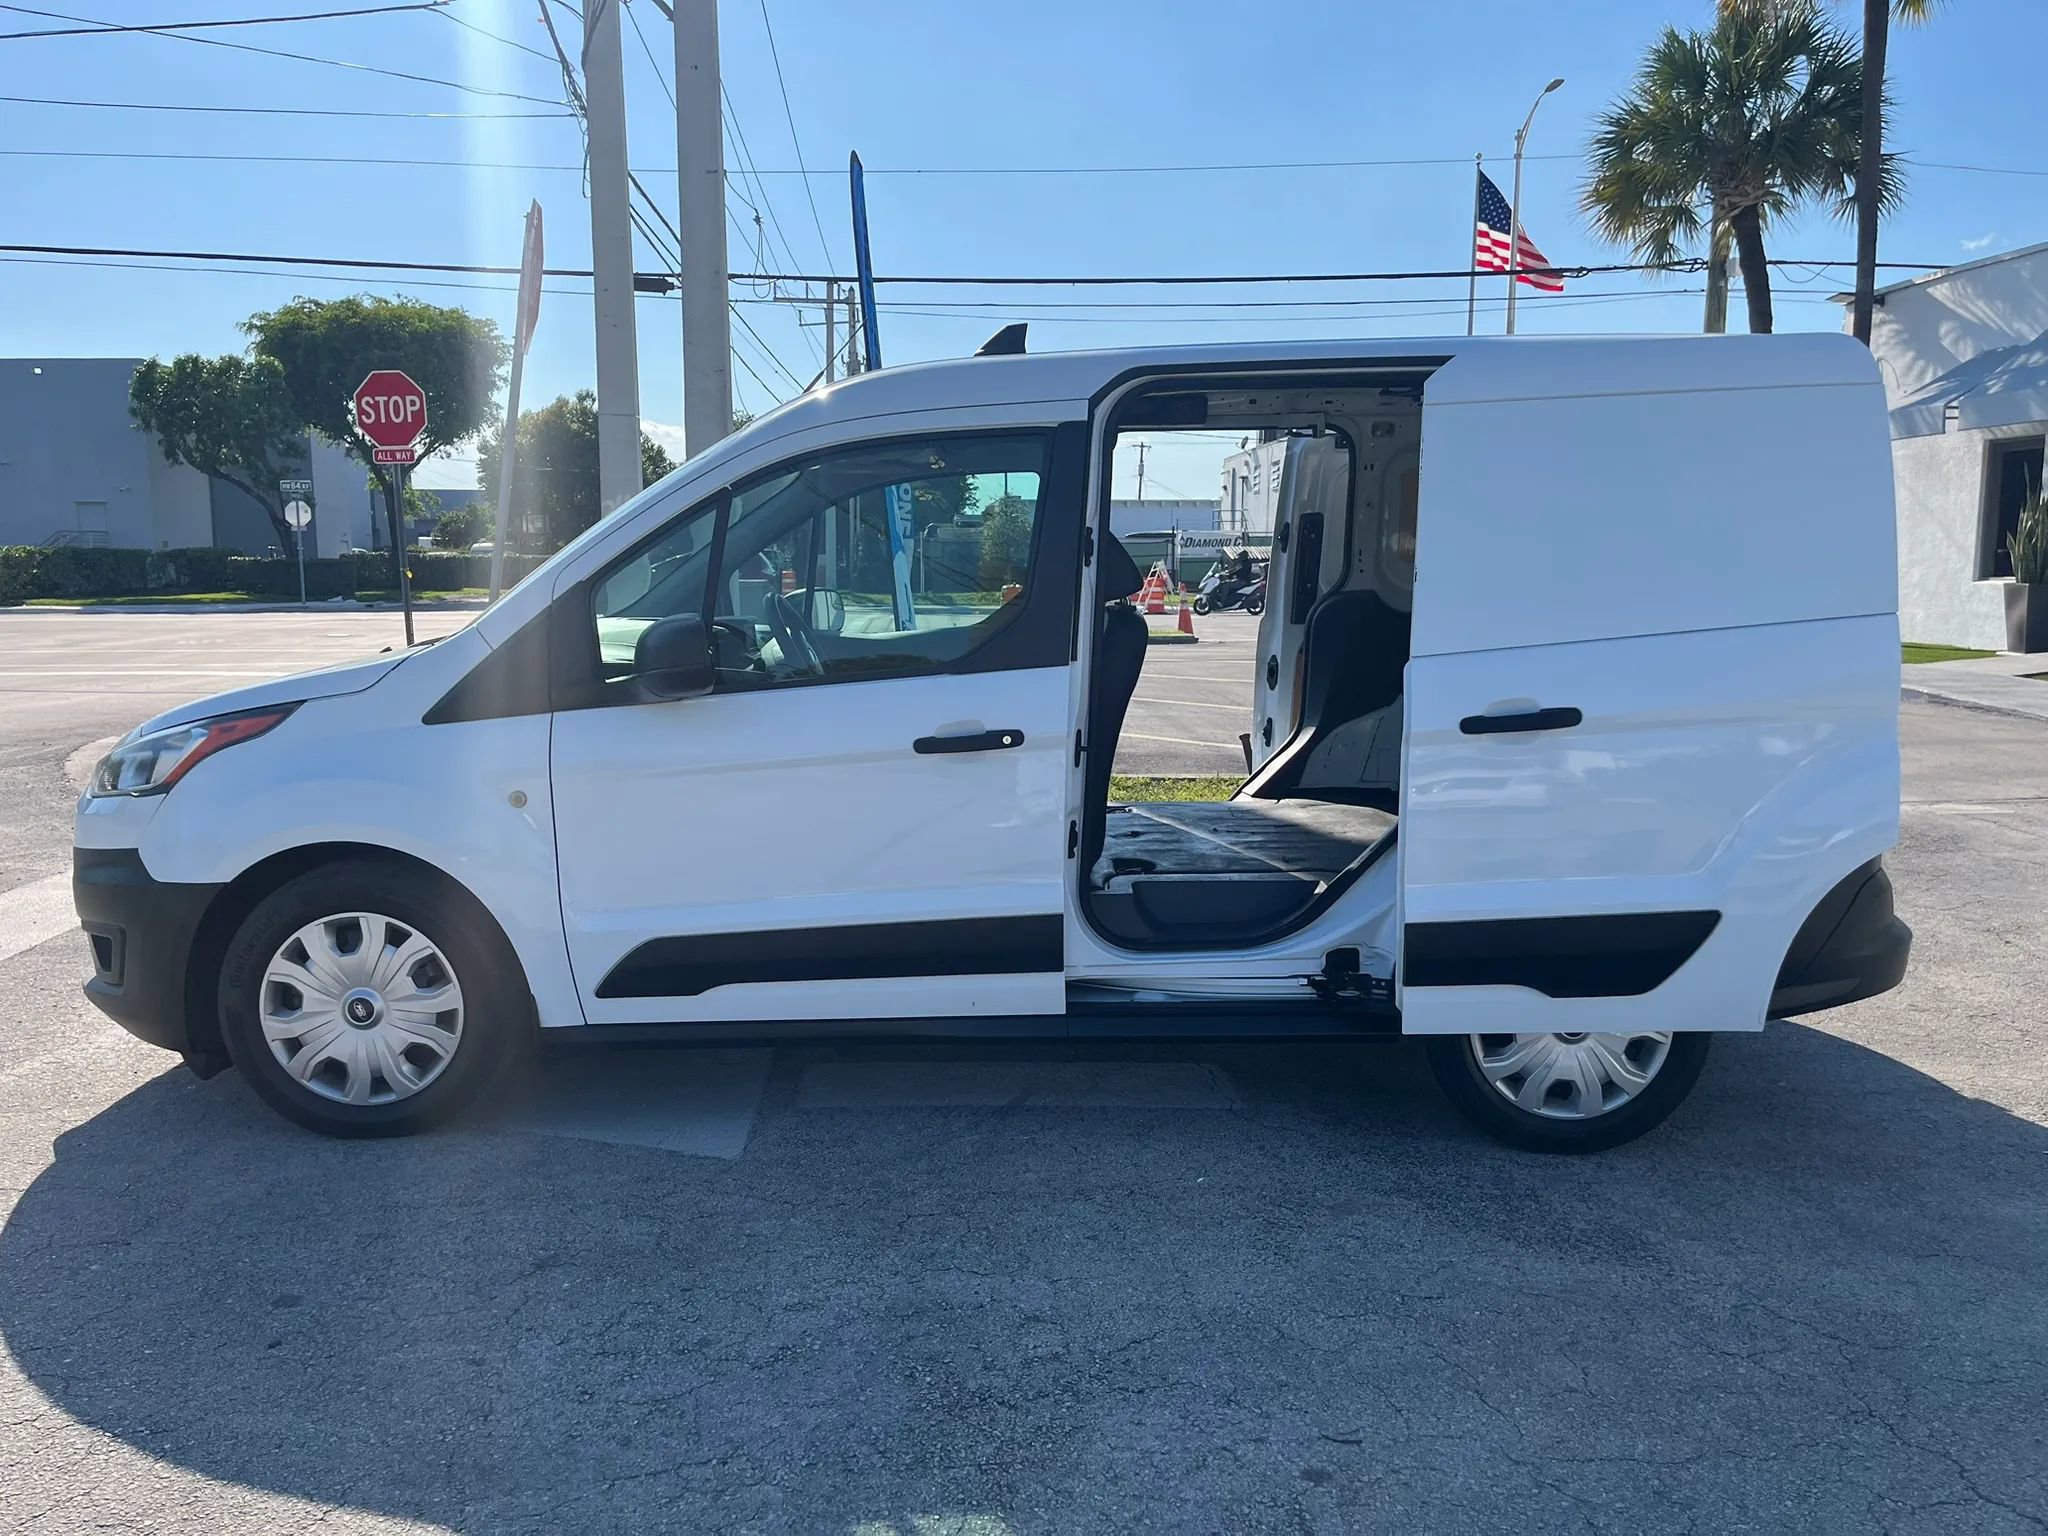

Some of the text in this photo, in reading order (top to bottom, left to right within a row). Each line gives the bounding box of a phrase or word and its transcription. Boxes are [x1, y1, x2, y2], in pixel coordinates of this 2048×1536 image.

[361, 395, 420, 424] STOP
[377, 451, 411, 461] ALL WAY
[1184, 537, 1231, 548] DIAMOND
